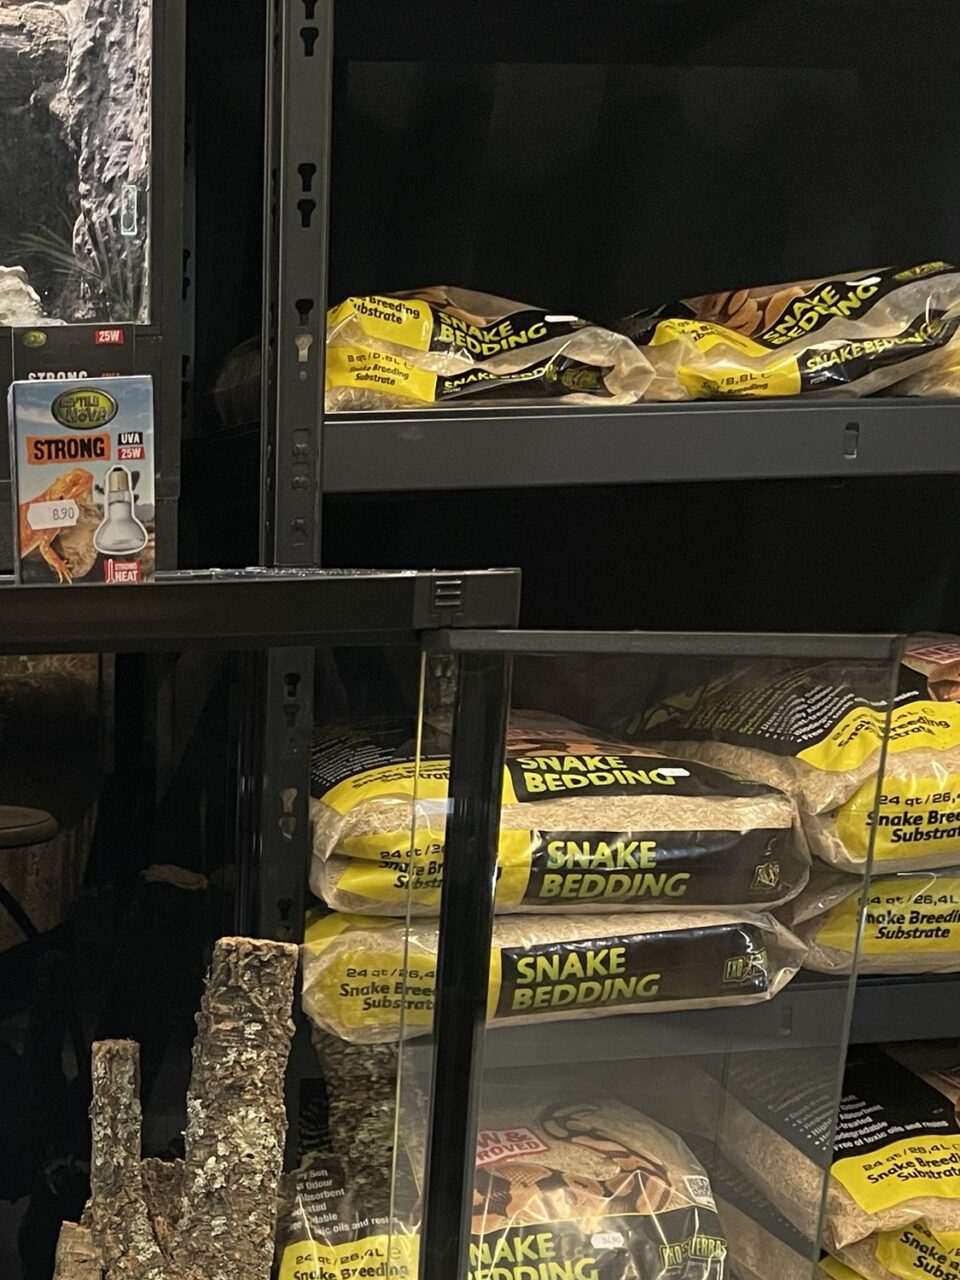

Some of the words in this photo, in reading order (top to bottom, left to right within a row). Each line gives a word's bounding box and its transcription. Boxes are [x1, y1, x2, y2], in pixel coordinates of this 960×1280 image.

[354, 302, 403, 324] ubstrate
[763, 285, 840, 342] SNAKE
[438, 312, 514, 342] SNAKE
[99, 330, 120, 342] 25W
[440, 322, 547, 356] BEDDING
[806, 345, 863, 373] SNAKE
[355, 373, 396, 386] Substrate
[372, 364, 409, 380] Breeding
[121, 433, 141, 444] UVA
[33, 437, 105, 461] STRONG
[121, 448, 141, 459] 25W
[53, 507, 75, 521] 8.90
[115, 571, 138, 582] HEAT
[886, 715, 951, 733] reeding
[516, 756, 628, 772] SNAKE
[524, 767, 677, 793] BEDDING
[879, 795, 900, 806] 24
[905, 796, 922, 807] qt
[932, 792, 960, 805] 26,
[866, 811, 923, 827] Snake
[927, 810, 960, 825] Bree
[380, 851, 401, 860] 24
[546, 840, 657, 870] SNAKE
[540, 873, 690, 898] BEDDING
[857, 909, 906, 924] nake
[909, 910, 960, 924] Breedi
[875, 926, 951, 939] Substrate
[346, 968, 368, 978] 24
[399, 969, 435, 980] 26,4
[516, 948, 627, 985] SNAKE
[339, 982, 390, 997] Snake
[394, 983, 436, 996] Bree
[512, 973, 661, 1011] BEDDING
[362, 997, 434, 1011] Substrat
[477, 1141, 541, 1161] ROVED
[867, 1159, 916, 1184] Snake
[897, 1166, 960, 1182] Substrat
[306, 1179, 333, 1190] Odour
[333, 1223, 350, 1233] oils
[352, 1217, 369, 1230] and
[371, 1216, 399, 1225] resis
[469, 1233, 556, 1266] NAKE
[900, 1231, 948, 1264] Snake
[341, 1262, 409, 1280] Breeding
